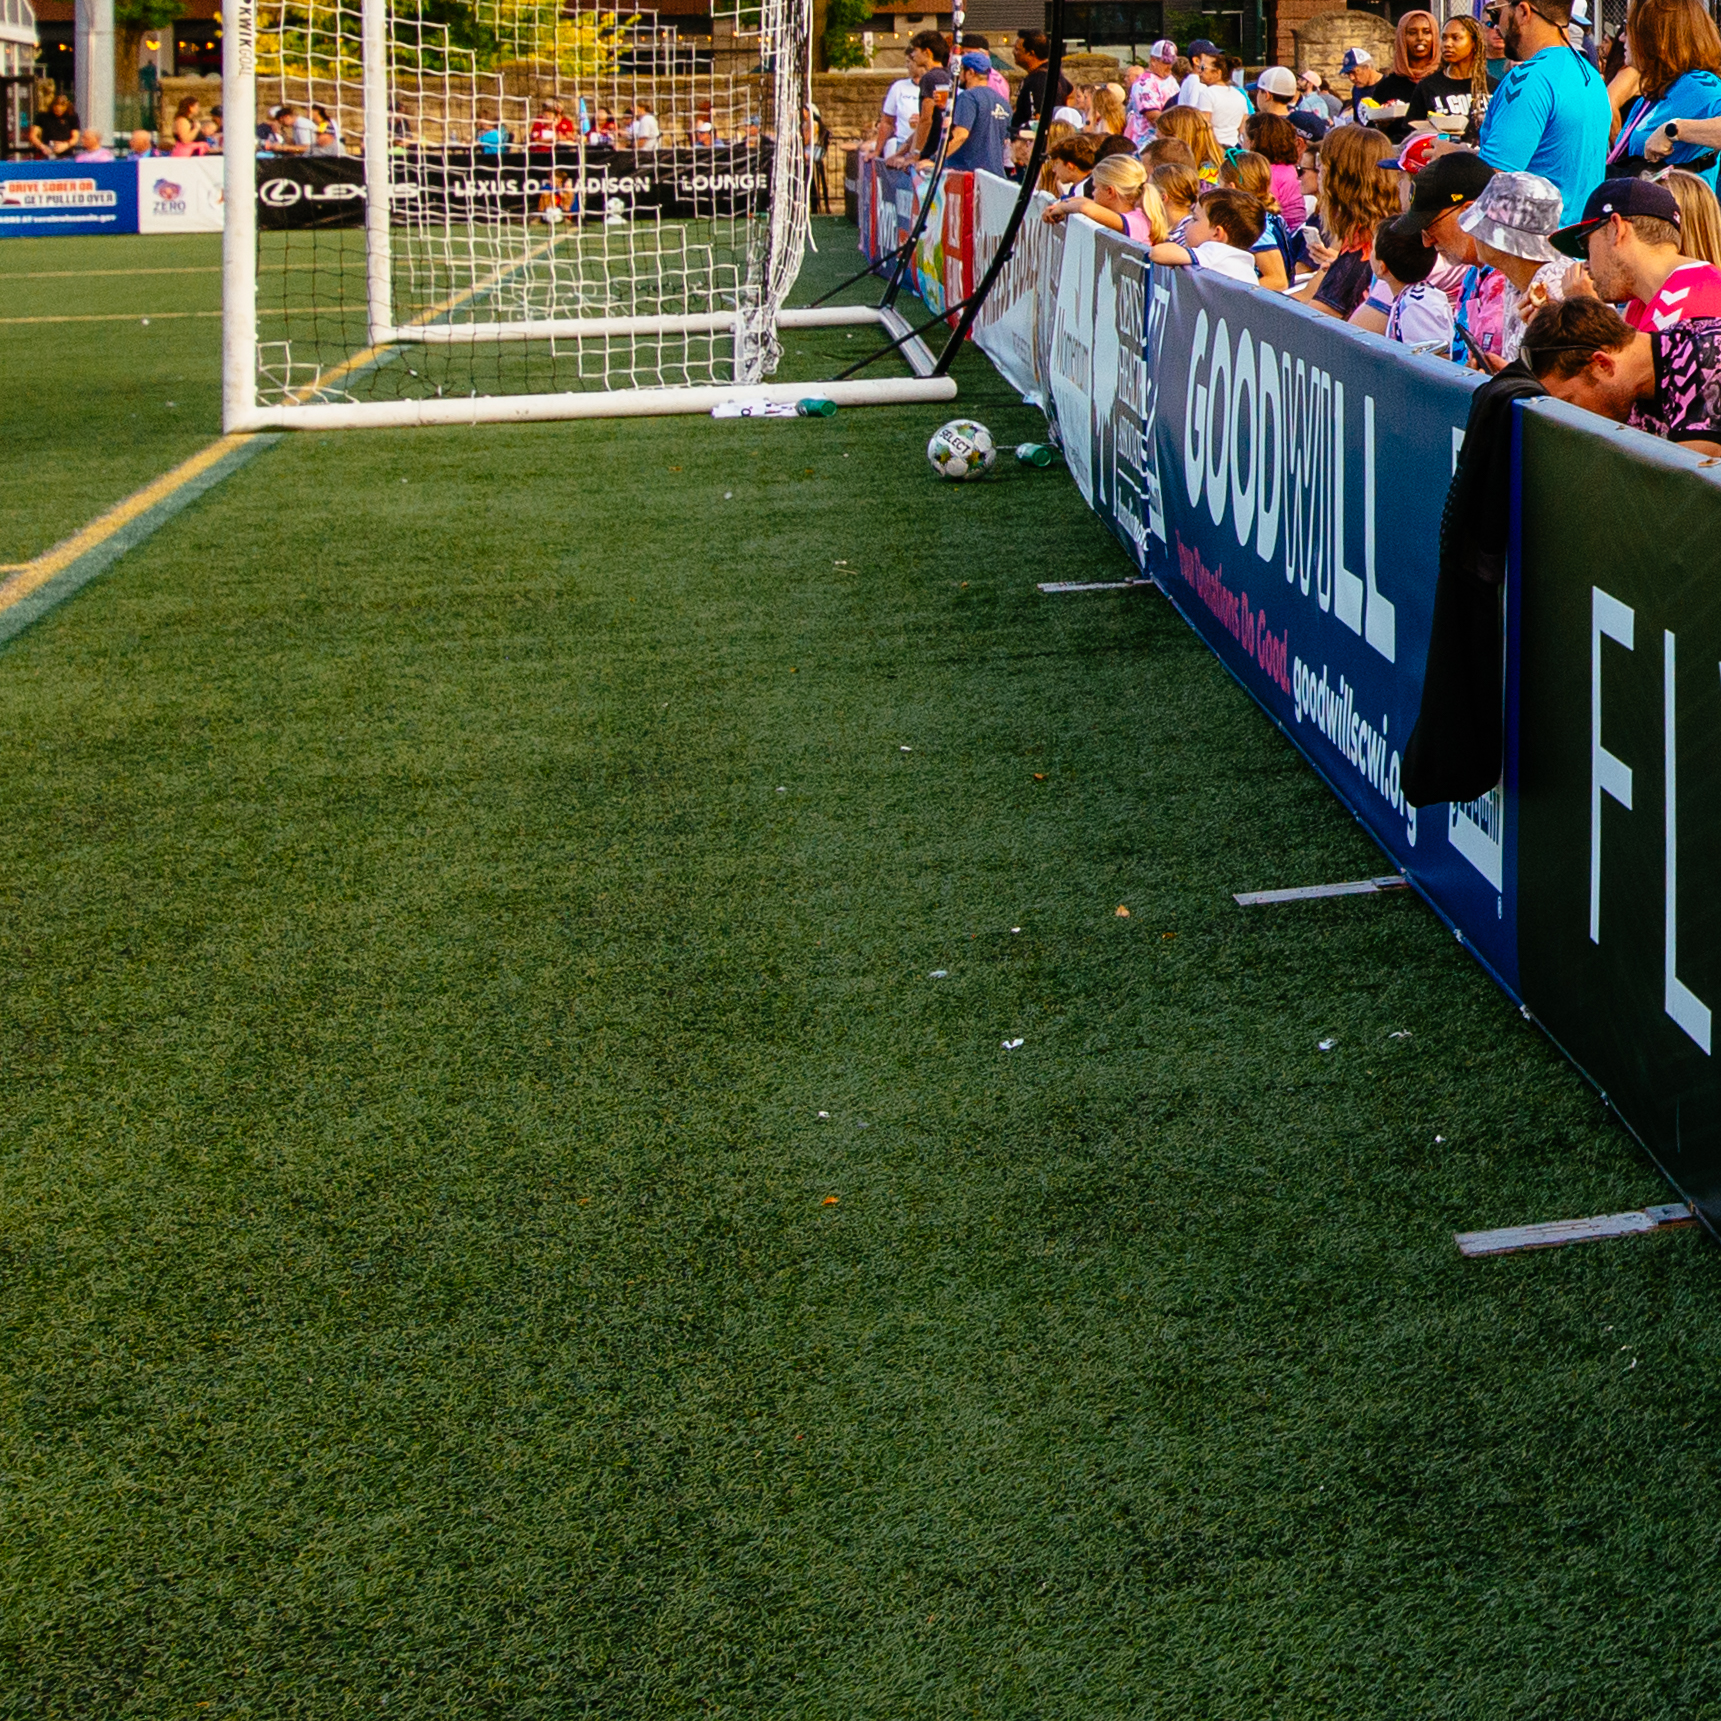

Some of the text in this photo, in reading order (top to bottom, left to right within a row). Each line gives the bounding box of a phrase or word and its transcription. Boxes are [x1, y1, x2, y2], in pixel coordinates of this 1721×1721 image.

[239, 6, 252, 48] KWIK
[303, 183, 419, 200] LEXS
[453, 178, 518, 197] LEXUS
[681, 174, 768, 192] LOUNGE
[153, 200, 186, 211] ZERO
[940, 429, 971, 455] SELECT
[1184, 308, 1396, 664] GOODWILL
